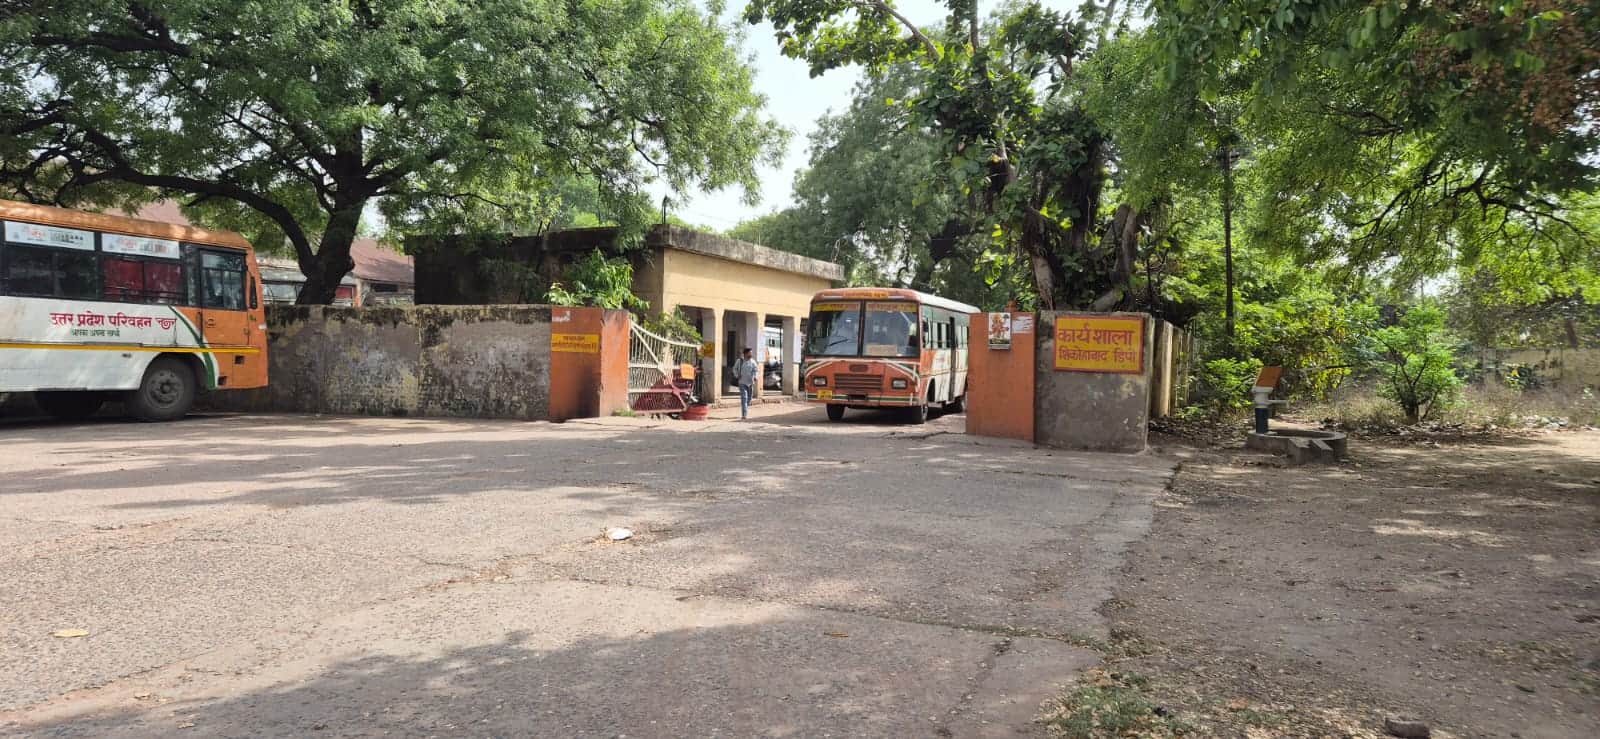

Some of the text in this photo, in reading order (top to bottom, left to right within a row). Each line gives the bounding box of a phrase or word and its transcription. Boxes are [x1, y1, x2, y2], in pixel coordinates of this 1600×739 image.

[50, 311, 152, 328] उत्तर प्रदेश परिवहन
